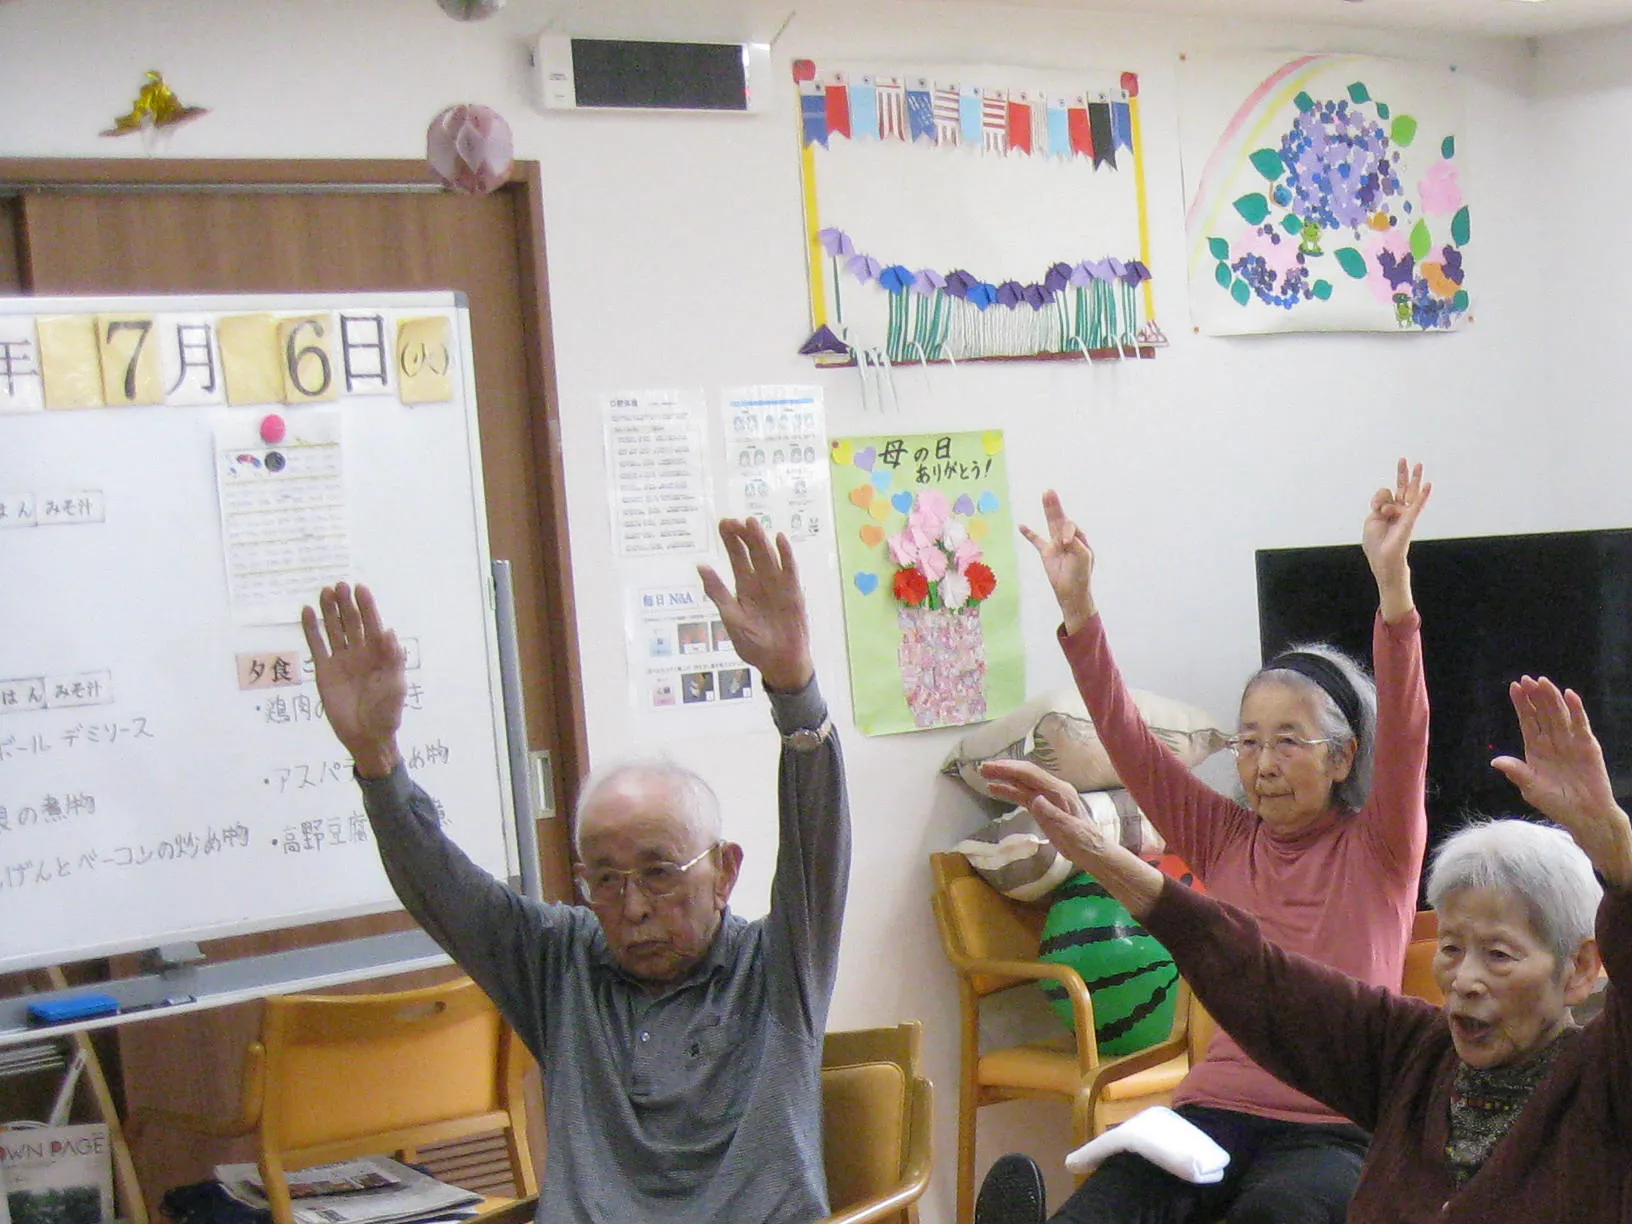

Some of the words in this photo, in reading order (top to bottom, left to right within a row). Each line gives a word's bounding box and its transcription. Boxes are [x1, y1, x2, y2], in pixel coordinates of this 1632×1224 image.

[878, 436, 952, 469] 母の日
[249, 656, 293, 684] 夕食
[55, 680, 102, 699] みそ汁
[50, 1136, 105, 1157] PAGE
